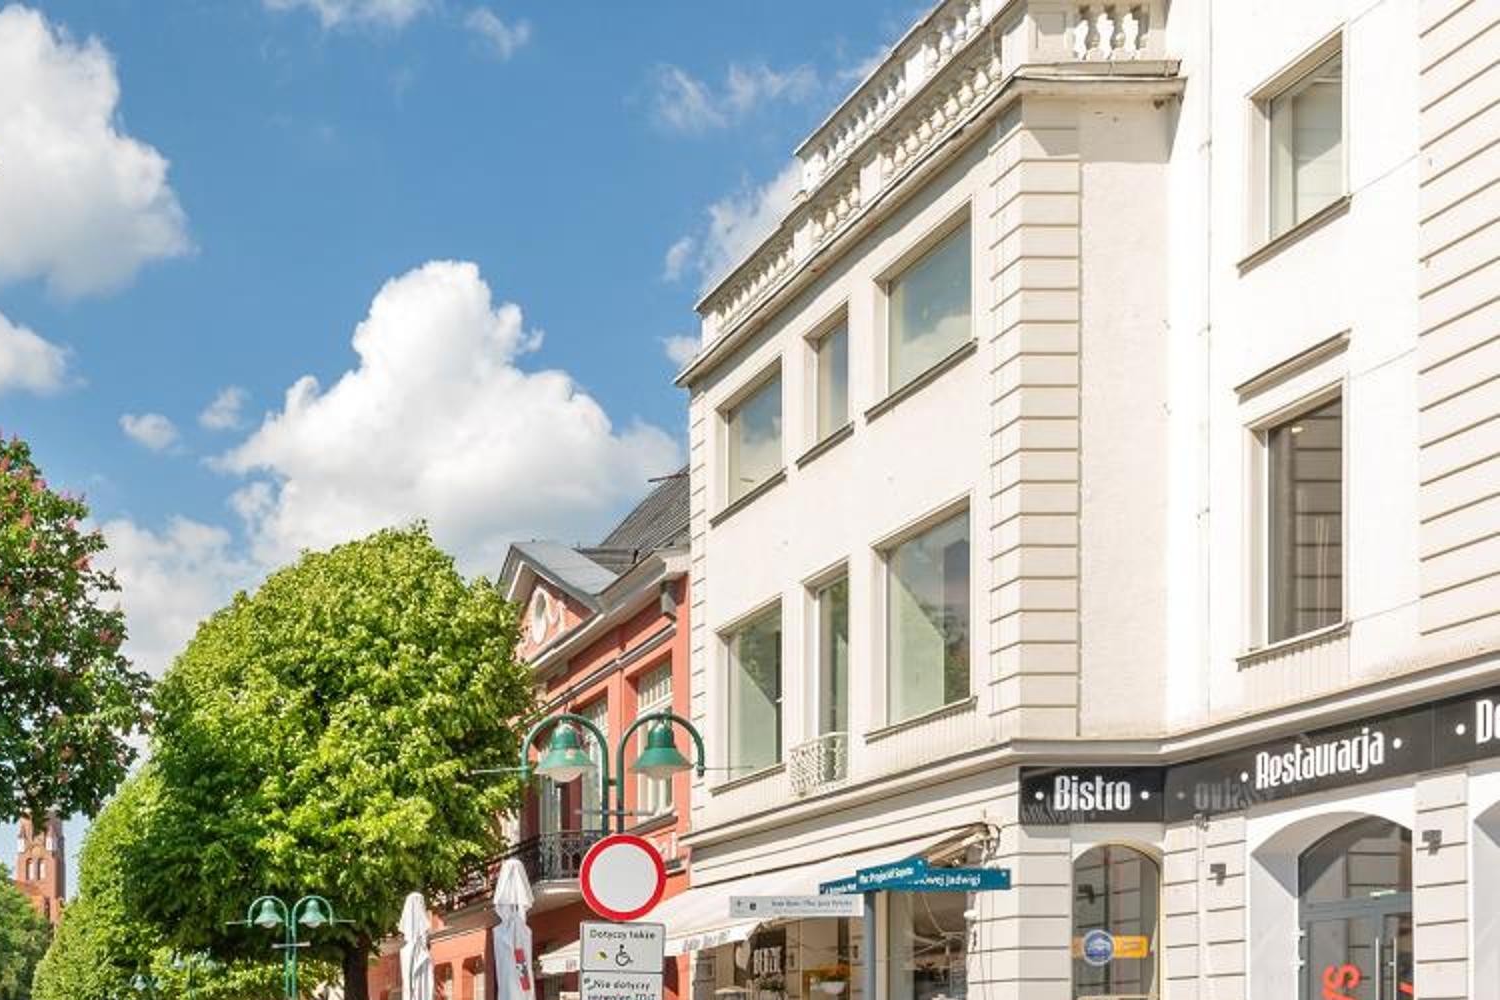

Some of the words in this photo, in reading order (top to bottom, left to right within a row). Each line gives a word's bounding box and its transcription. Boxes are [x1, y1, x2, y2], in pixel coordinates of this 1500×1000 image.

[1255, 728, 1385, 790] Restauracja
[1053, 775, 1132, 811] Bistro
[946, 872, 981, 886] Jadwigi
[589, 929, 627, 941] Dotyczy
[594, 979, 611, 989] Nie
[614, 980, 651, 991] dotyczy
